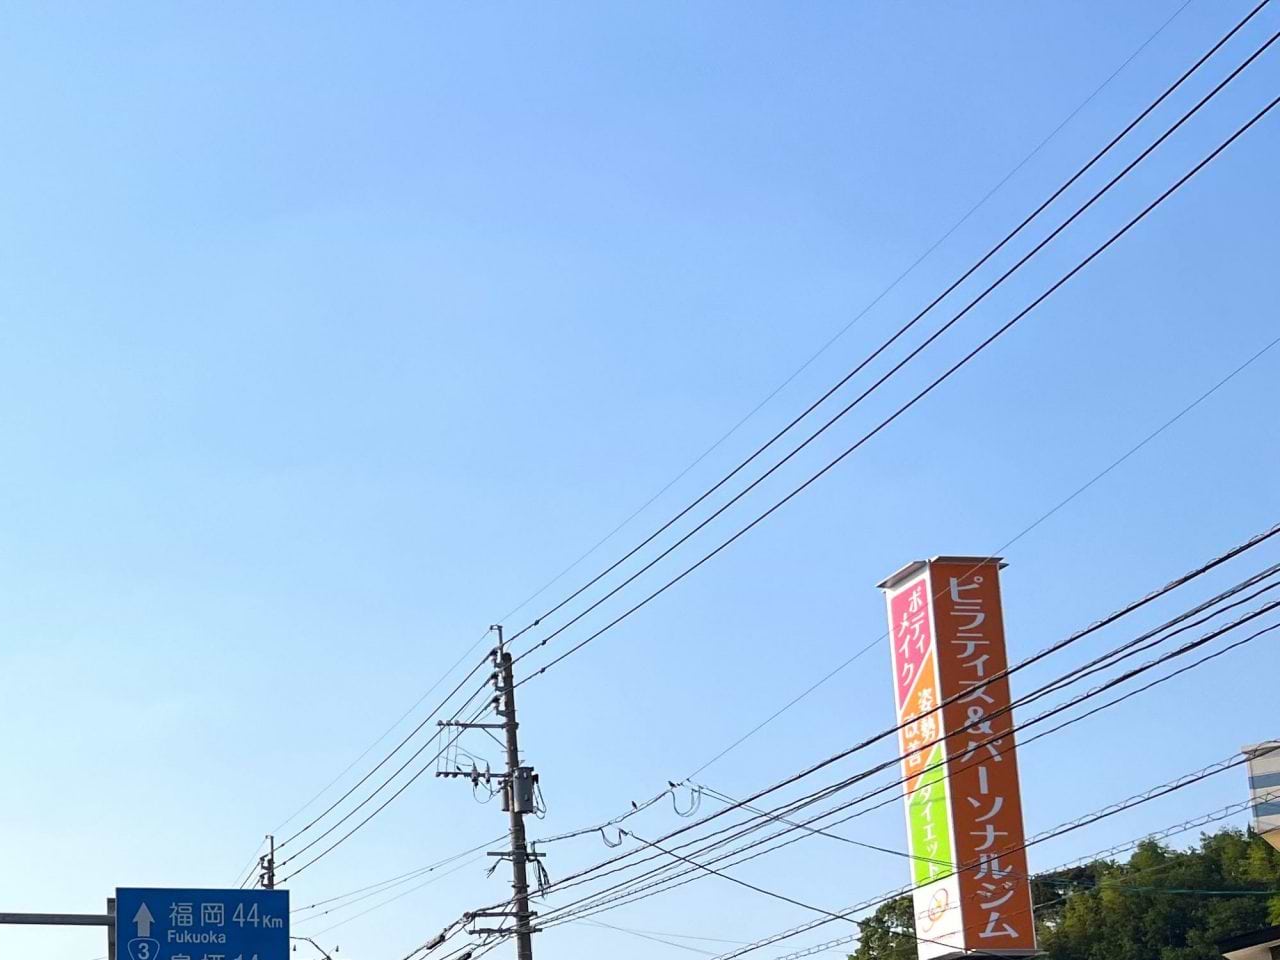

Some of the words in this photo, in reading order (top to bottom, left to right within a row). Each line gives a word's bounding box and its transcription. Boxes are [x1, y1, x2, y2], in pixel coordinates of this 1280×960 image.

[897, 611, 915, 687] メイク
[169, 902, 225, 927] 福岡
[168, 930, 226, 944] Fukuoka
[138, 943, 150, 960] 3
